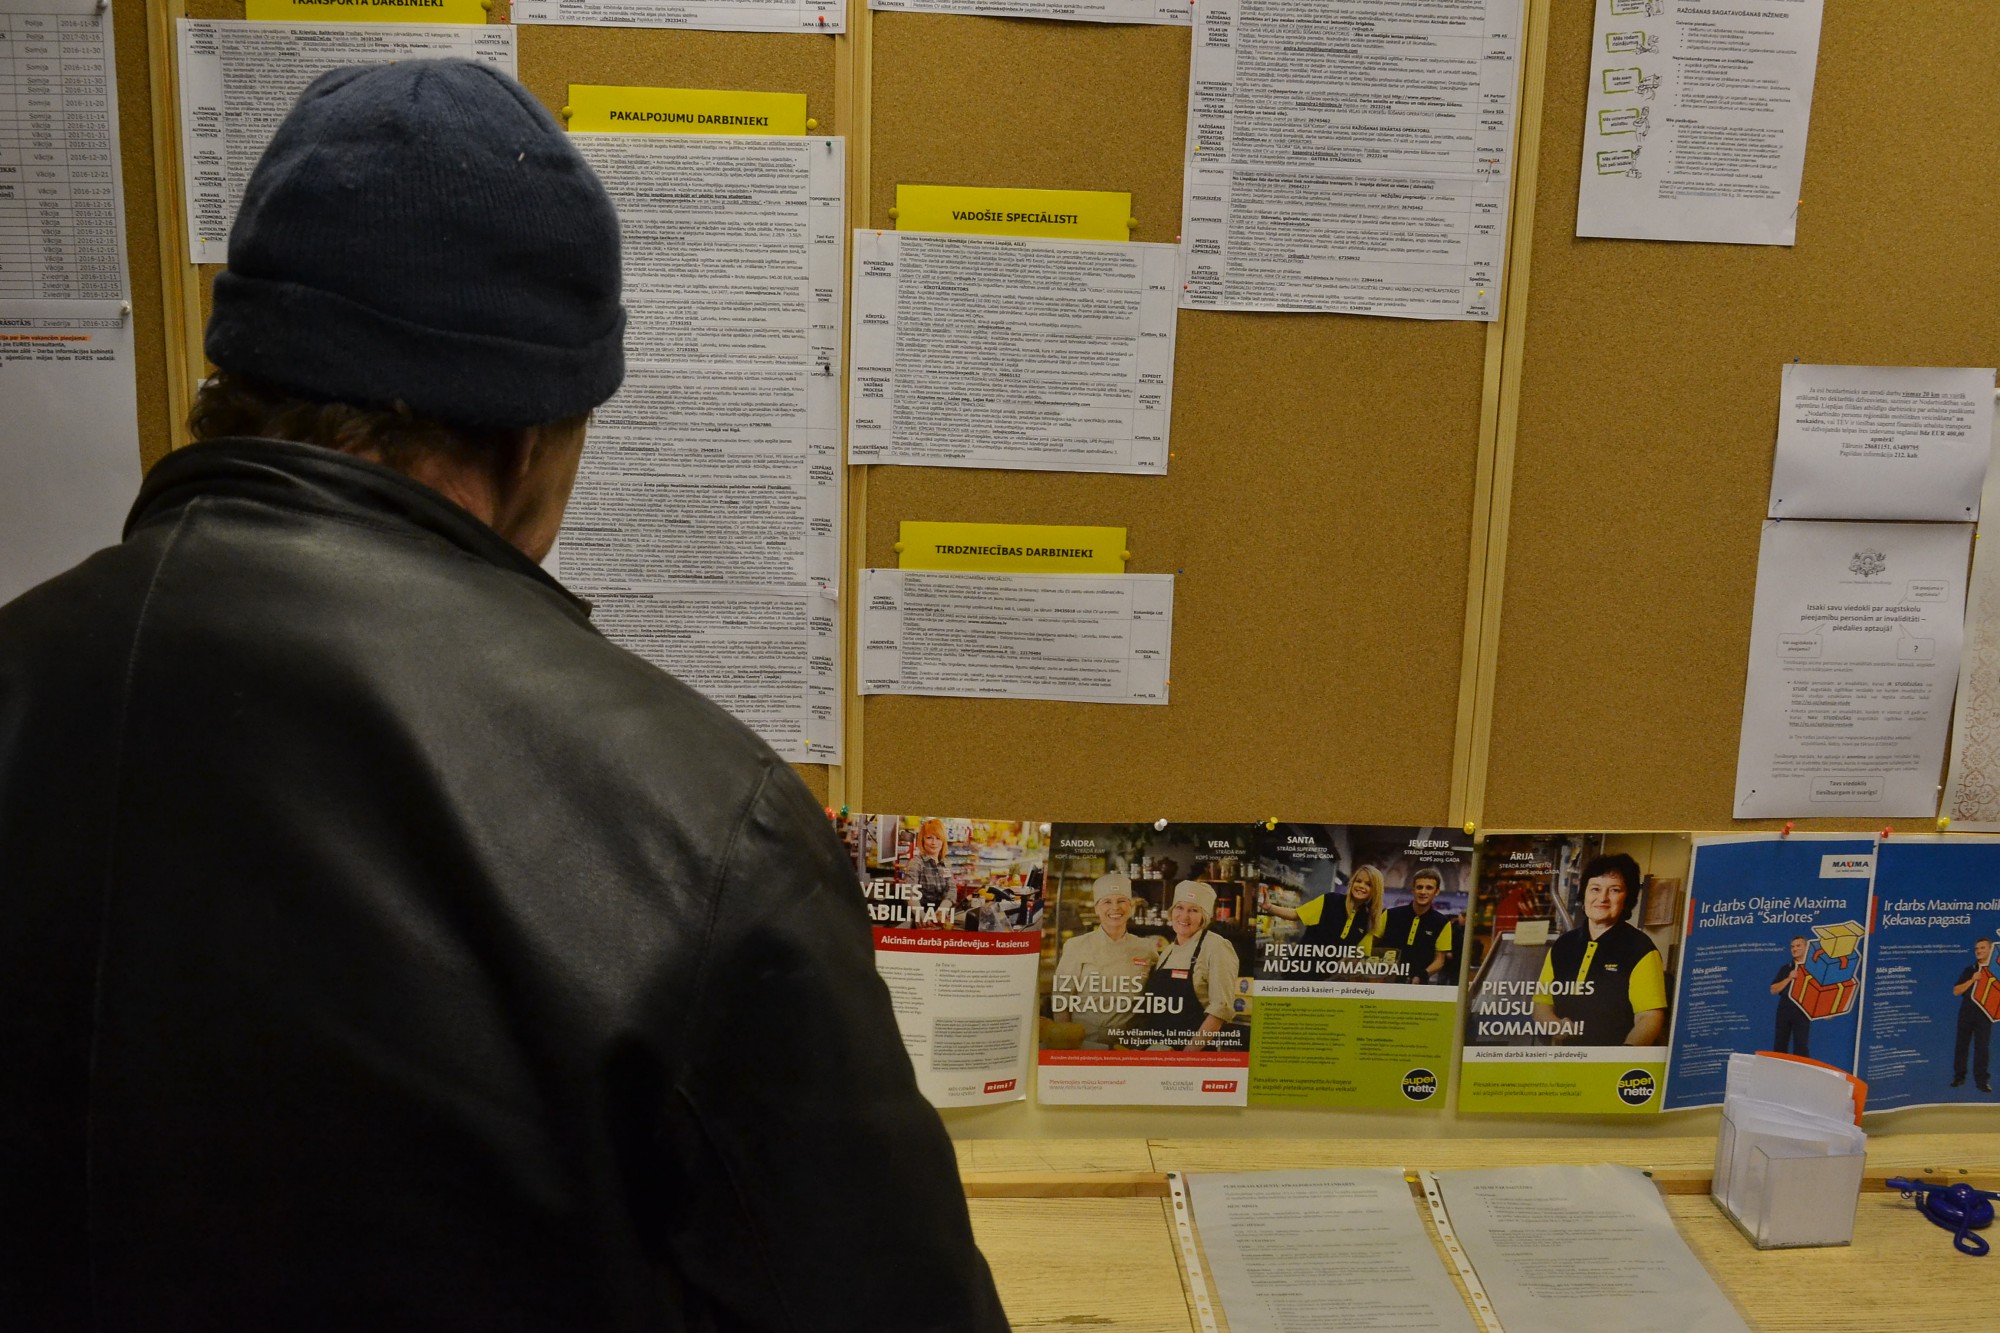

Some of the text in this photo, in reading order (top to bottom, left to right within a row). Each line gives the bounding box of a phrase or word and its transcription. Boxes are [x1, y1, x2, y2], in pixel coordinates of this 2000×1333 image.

[372, 0, 444, 8] DARBINIEKI
[1676, 7, 1790, 19] RAŽOŠANAS SAGATAVOŠANAS INŽENIERI
[610, 110, 769, 127] PAKALPOJUMU DARBINIEKI
[952, 208, 1078, 225] VADOŠIE SPECIĀLISTI
[935, 544, 1094, 558] TIRDZNIECĪBAS DARBINIEKI
[1844, 604, 1871, 612] viedokli
[1885, 605, 1921, 614] augstskolu
[1800, 614, 1839, 622] pieejamību
[1840, 615, 1874, 623] personām
[1832, 624, 1893, 633] piedalies aptaujā!
[1914, 645, 1919, 653] ?
[1060, 840, 1095, 848] SANDRA
[1208, 840, 1230, 848] VERA
[1287, 836, 1315, 844] SANTA
[1408, 840, 1450, 850] JEVGEŅIJS
[1510, 852, 1534, 860] ĀRIJA
[1702, 902, 1711, 914] Ir
[1713, 898, 1746, 913] darbs
[1794, 896, 1847, 910] Maxima
[1884, 900, 1893, 911] Ir
[1894, 899, 1926, 911] darbs
[1927, 899, 1974, 911] Maxima
[1700, 913, 1754, 928] noliktavā
[1882, 914, 1971, 930] Ķekavas pagastā
[881, 935, 916, 946] Aicinām
[917, 936, 942, 947] darbā
[943, 939, 990, 951] pārdevējus
[996, 940, 1030, 949] kasierus
[1265, 944, 1365, 959] PIEVIENOJIES
[1263, 958, 1410, 976] MŪSU KOMANDAI!
[1692, 967, 1705, 975] Mēs
[1052, 972, 1143, 993] IZVĒLIES
[1312, 986, 1334, 994] kasieri
[1341, 987, 1375, 996] pārdevēju
[1482, 981, 1595, 996] PIEVIENOJIES
[1052, 992, 1184, 1014] DRAUDZĪBU
[1480, 998, 1534, 1016] MŪSU
[1108, 1028, 1241, 1038] Mēs vēlamies, lai mūsu komandā
[1478, 1021, 1585, 1036] KOMANDAI!
[1119, 1038, 1243, 1048] Tu izjustu atbalstu un sapratni.
[1504, 1050, 1524, 1058] darbā
[1554, 1052, 1588, 1060] pārdevēju
[1403, 1076, 1435, 1086] super
[1618, 1077, 1653, 1089] super
[1407, 1084, 1436, 1094] netto
[1623, 1086, 1654, 1097] netto
